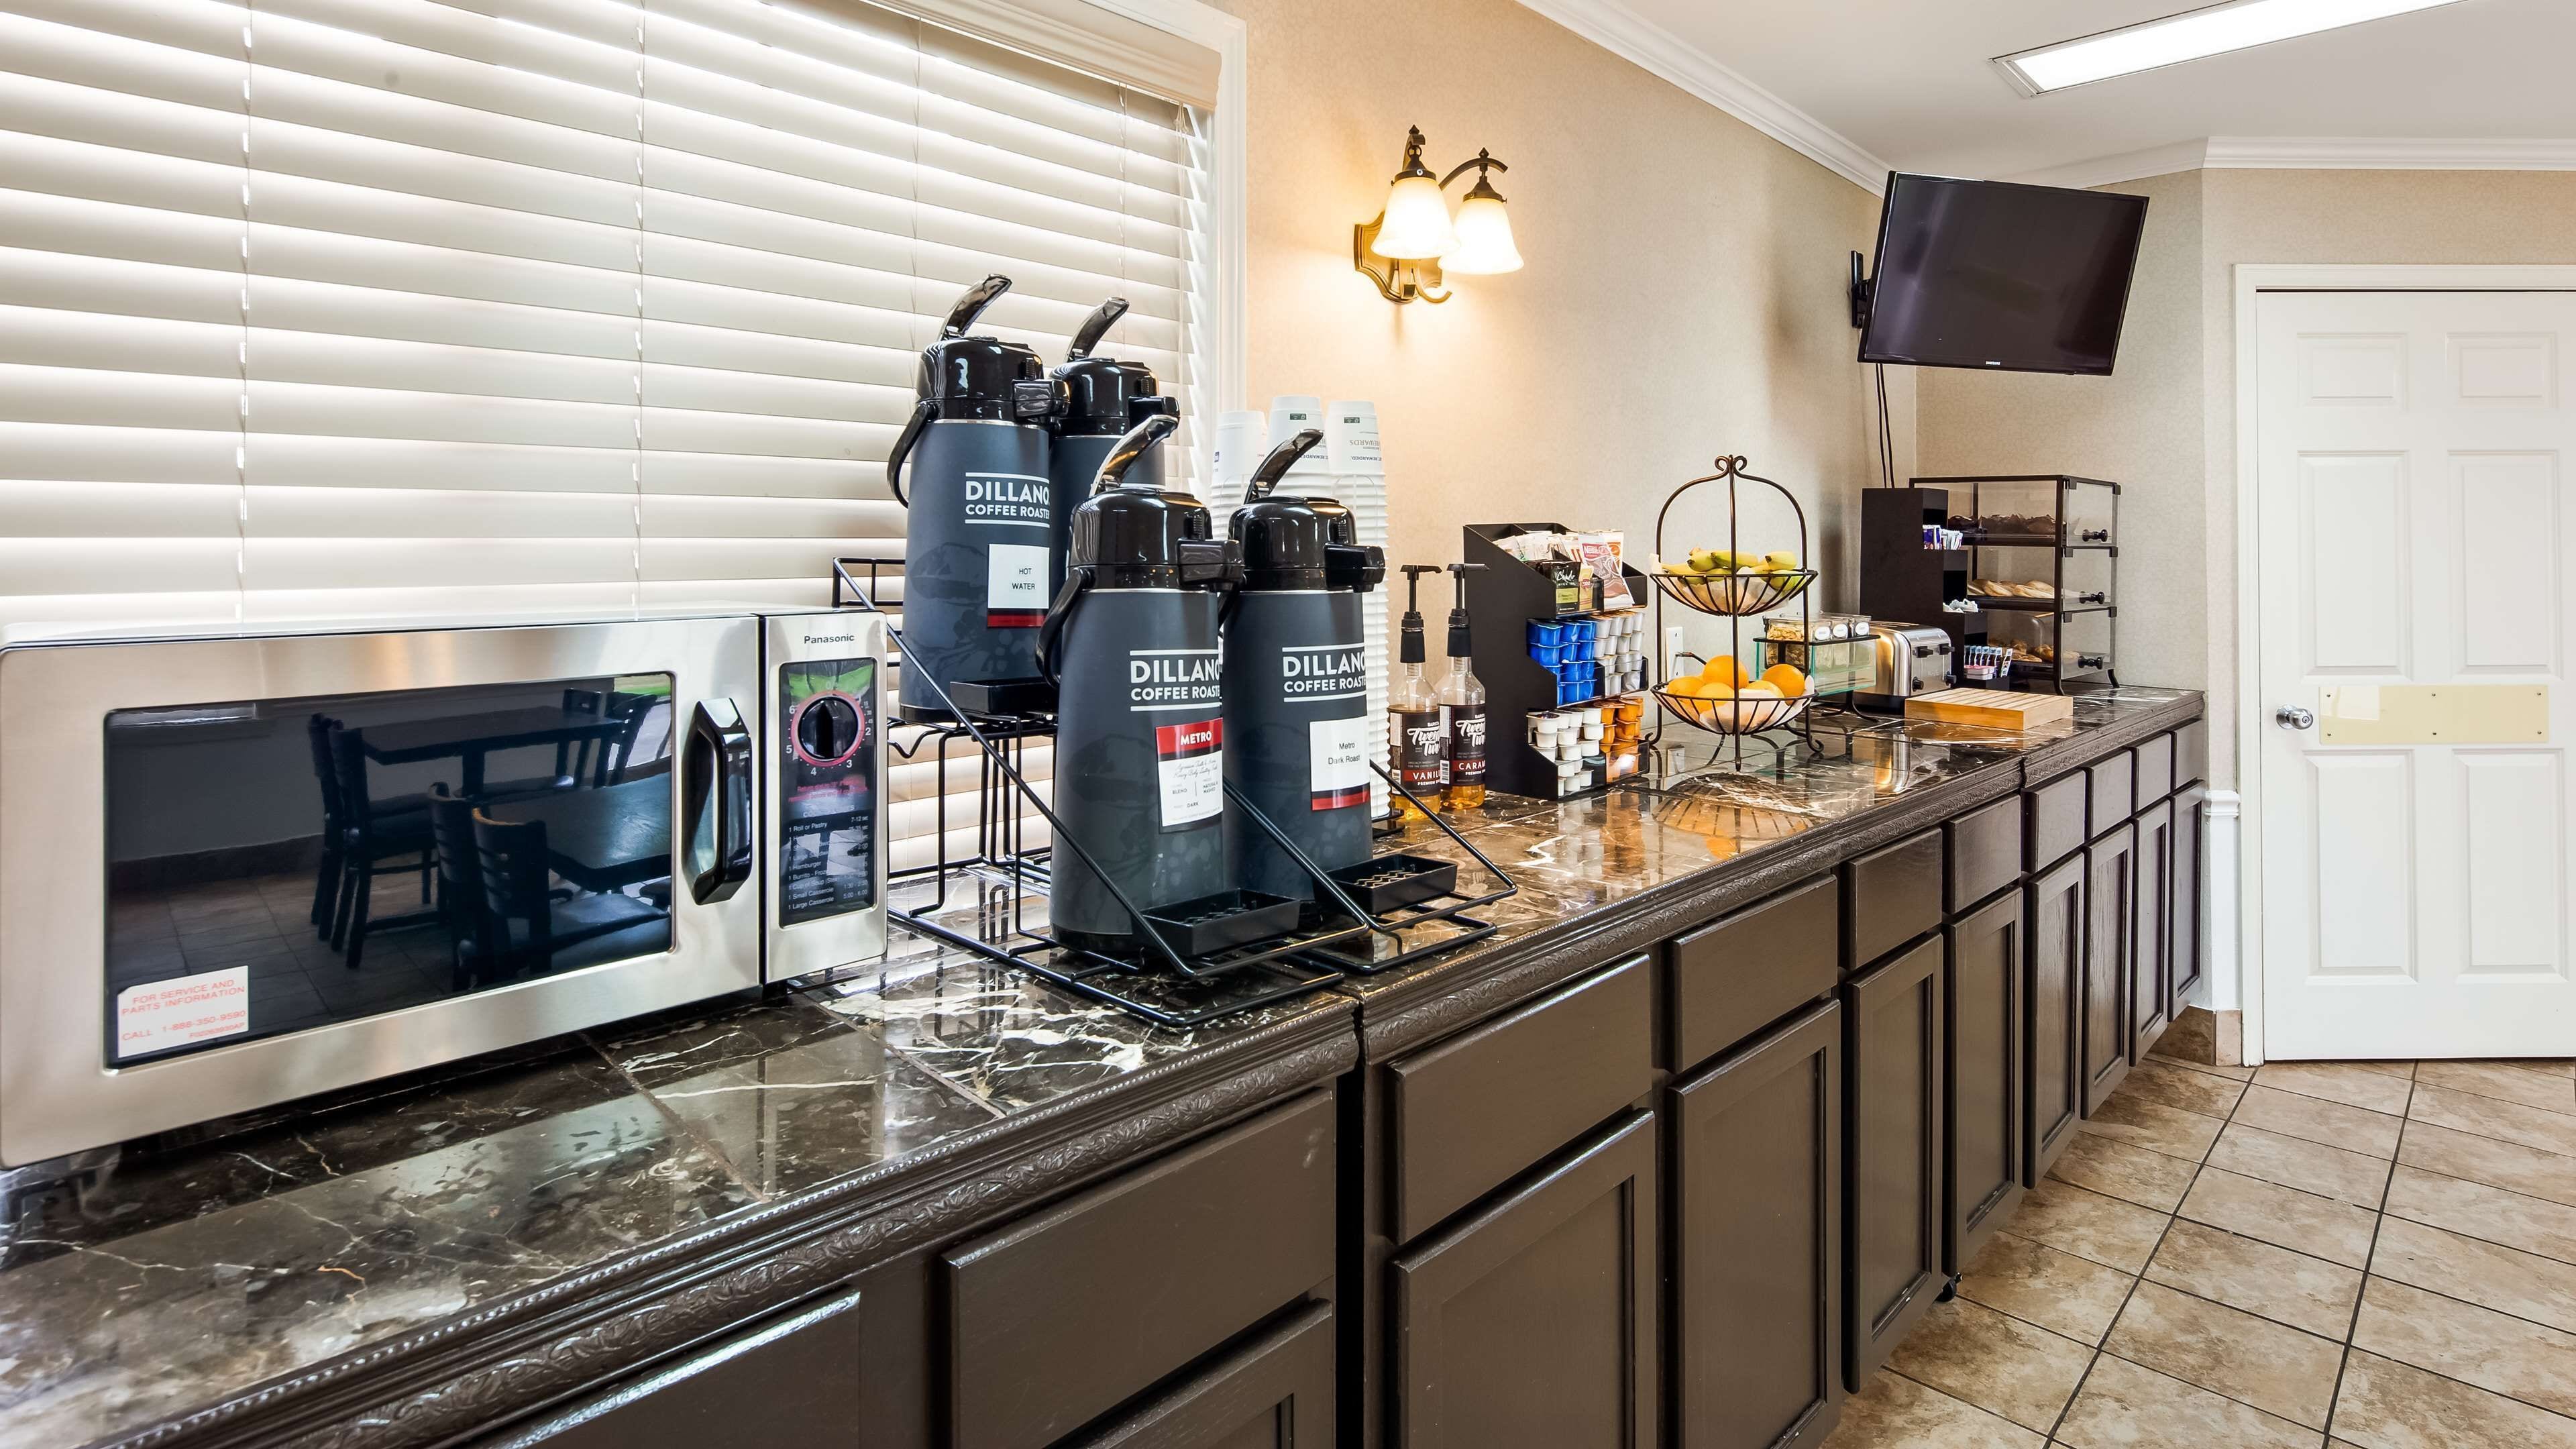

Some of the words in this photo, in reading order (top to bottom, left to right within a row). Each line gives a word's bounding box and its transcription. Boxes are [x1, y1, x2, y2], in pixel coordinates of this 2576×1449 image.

[966, 480, 1050, 505] DILLANO
[965, 504, 1017, 516] COFFEE
[1012, 582, 1036, 590] WATER
[804, 633, 855, 645] Panasonic
[1283, 679, 1336, 693] COFFEE
[1130, 686, 1189, 701] COFFEE
[789, 705, 796, 714] 6
[865, 727, 871, 736] 2
[1180, 731, 1212, 746] METRO
[786, 745, 792, 753] 5
[1338, 741, 1356, 750] Metro
[846, 759, 852, 768] 3
[1328, 756, 1344, 765] Dark
[1346, 754, 1360, 763] Roast
[810, 767, 816, 775] 4
[792, 902, 808, 910] Large
[133, 994, 157, 1004] FOR
[160, 983, 208, 1000] SERVICE
[211, 979, 235, 989] AND
[121, 1002, 162, 1016] PARTS
[165, 986, 246, 1007] INFORMATION
[122, 1029, 154, 1041] CALL
